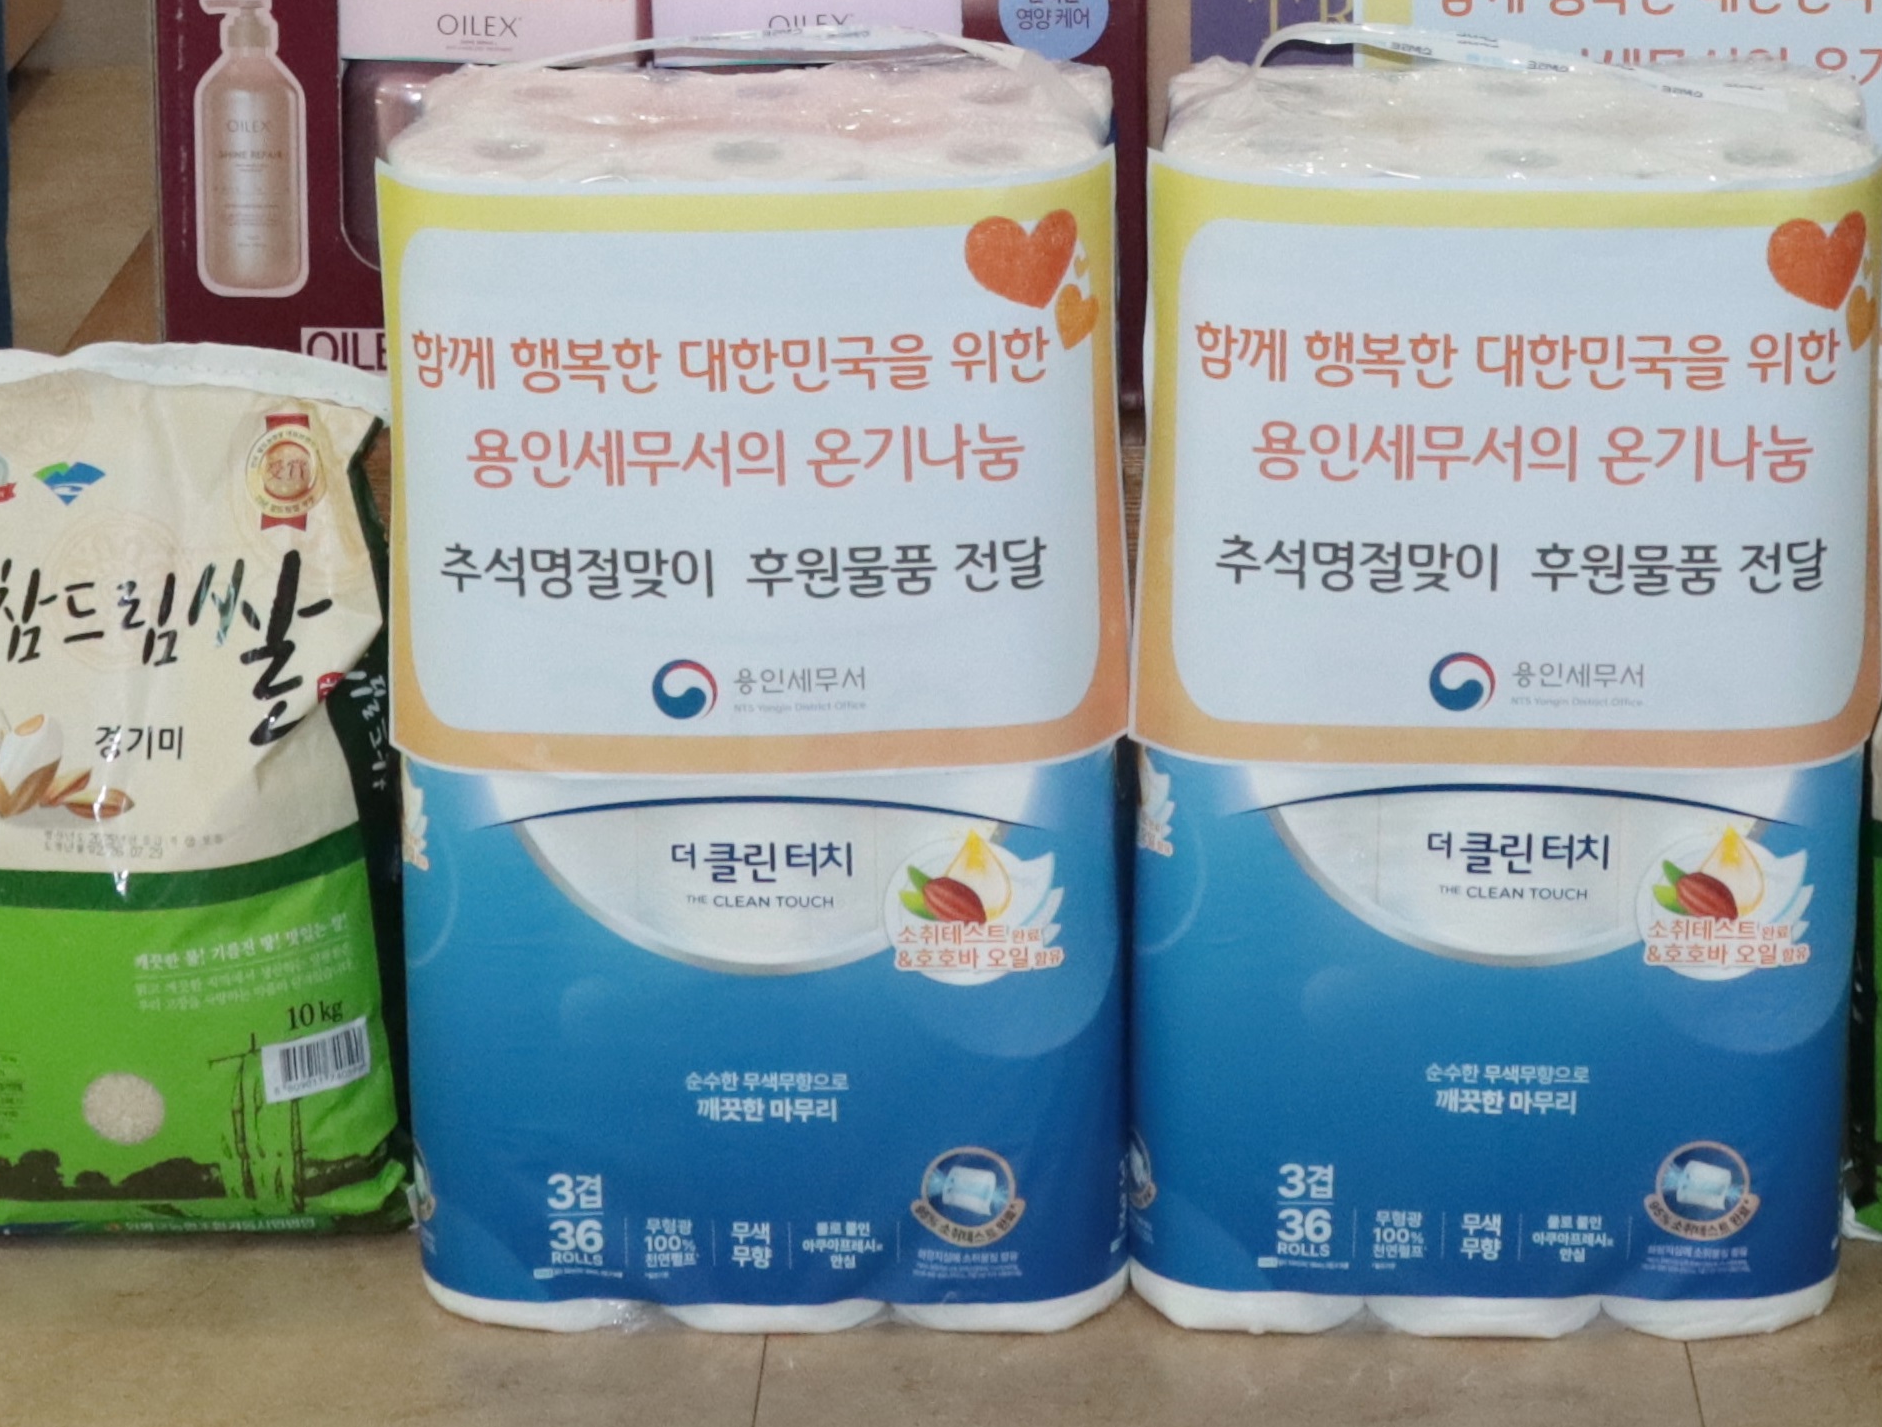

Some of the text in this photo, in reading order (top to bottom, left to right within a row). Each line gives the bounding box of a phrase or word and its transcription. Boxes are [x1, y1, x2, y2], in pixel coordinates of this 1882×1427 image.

[437, 15, 519, 37] OILEX
[1016, 7, 1090, 30] 영양 케어
[226, 120, 270, 133] OILEX
[307, 331, 388, 370] OILE
[1195, 321, 1841, 391] 함께 행복한 대한민국을 위한
[1251, 420, 1814, 485] 용인세무서의 온기나눔
[1216, 536, 1828, 596] 추석명절맞이 후원물품 전달
[1512, 661, 1645, 690] 용인세무서
[95, 726, 185, 762] 경기미
[1427, 832, 1610, 874] 더 클린 터치
[1439, 886, 1589, 901] THE CLEAN TOUCH
[1648, 920, 1757, 942] 소취테스트
[1647, 943, 1730, 964] &호호바
[1736, 943, 1777, 964] 오일
[288, 1000, 343, 1030] 10 kg
[1426, 1063, 1591, 1084] 순수한 무색무향으로
[1434, 1089, 1577, 1115] 깨끗한 마무리
[1278, 1163, 1334, 1200] 3겹
[1278, 1208, 1332, 1242] 36
[1373, 1228, 1424, 1245] 100%
[1461, 1214, 1502, 1236] 무색
[1278, 1243, 1330, 1257] ROLLS
[1461, 1237, 1502, 1261] 무향
